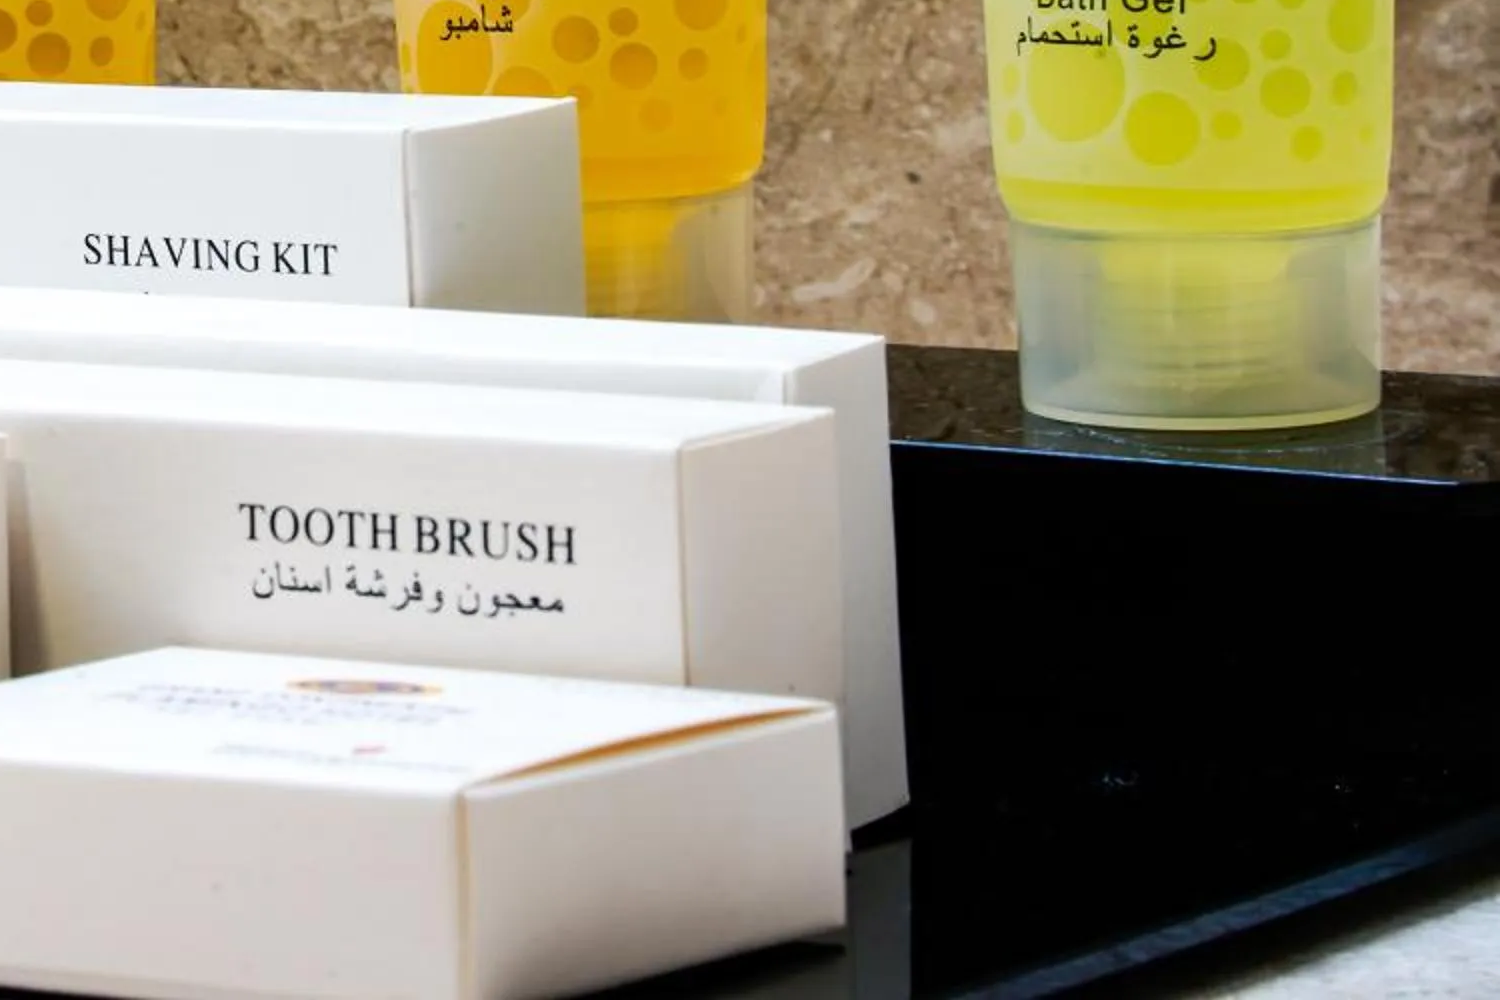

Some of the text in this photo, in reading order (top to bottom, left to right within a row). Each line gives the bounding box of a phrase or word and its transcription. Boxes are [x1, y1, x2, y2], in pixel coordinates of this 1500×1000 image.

[440, 4, 514, 40] شامبو
[1017, 16, 1113, 56] استحمام
[83, 233, 338, 276] SHAVING KIT
[238, 502, 577, 565] TOOTH BRUSH
[252, 561, 565, 618] معجون وفرشة اسنان
